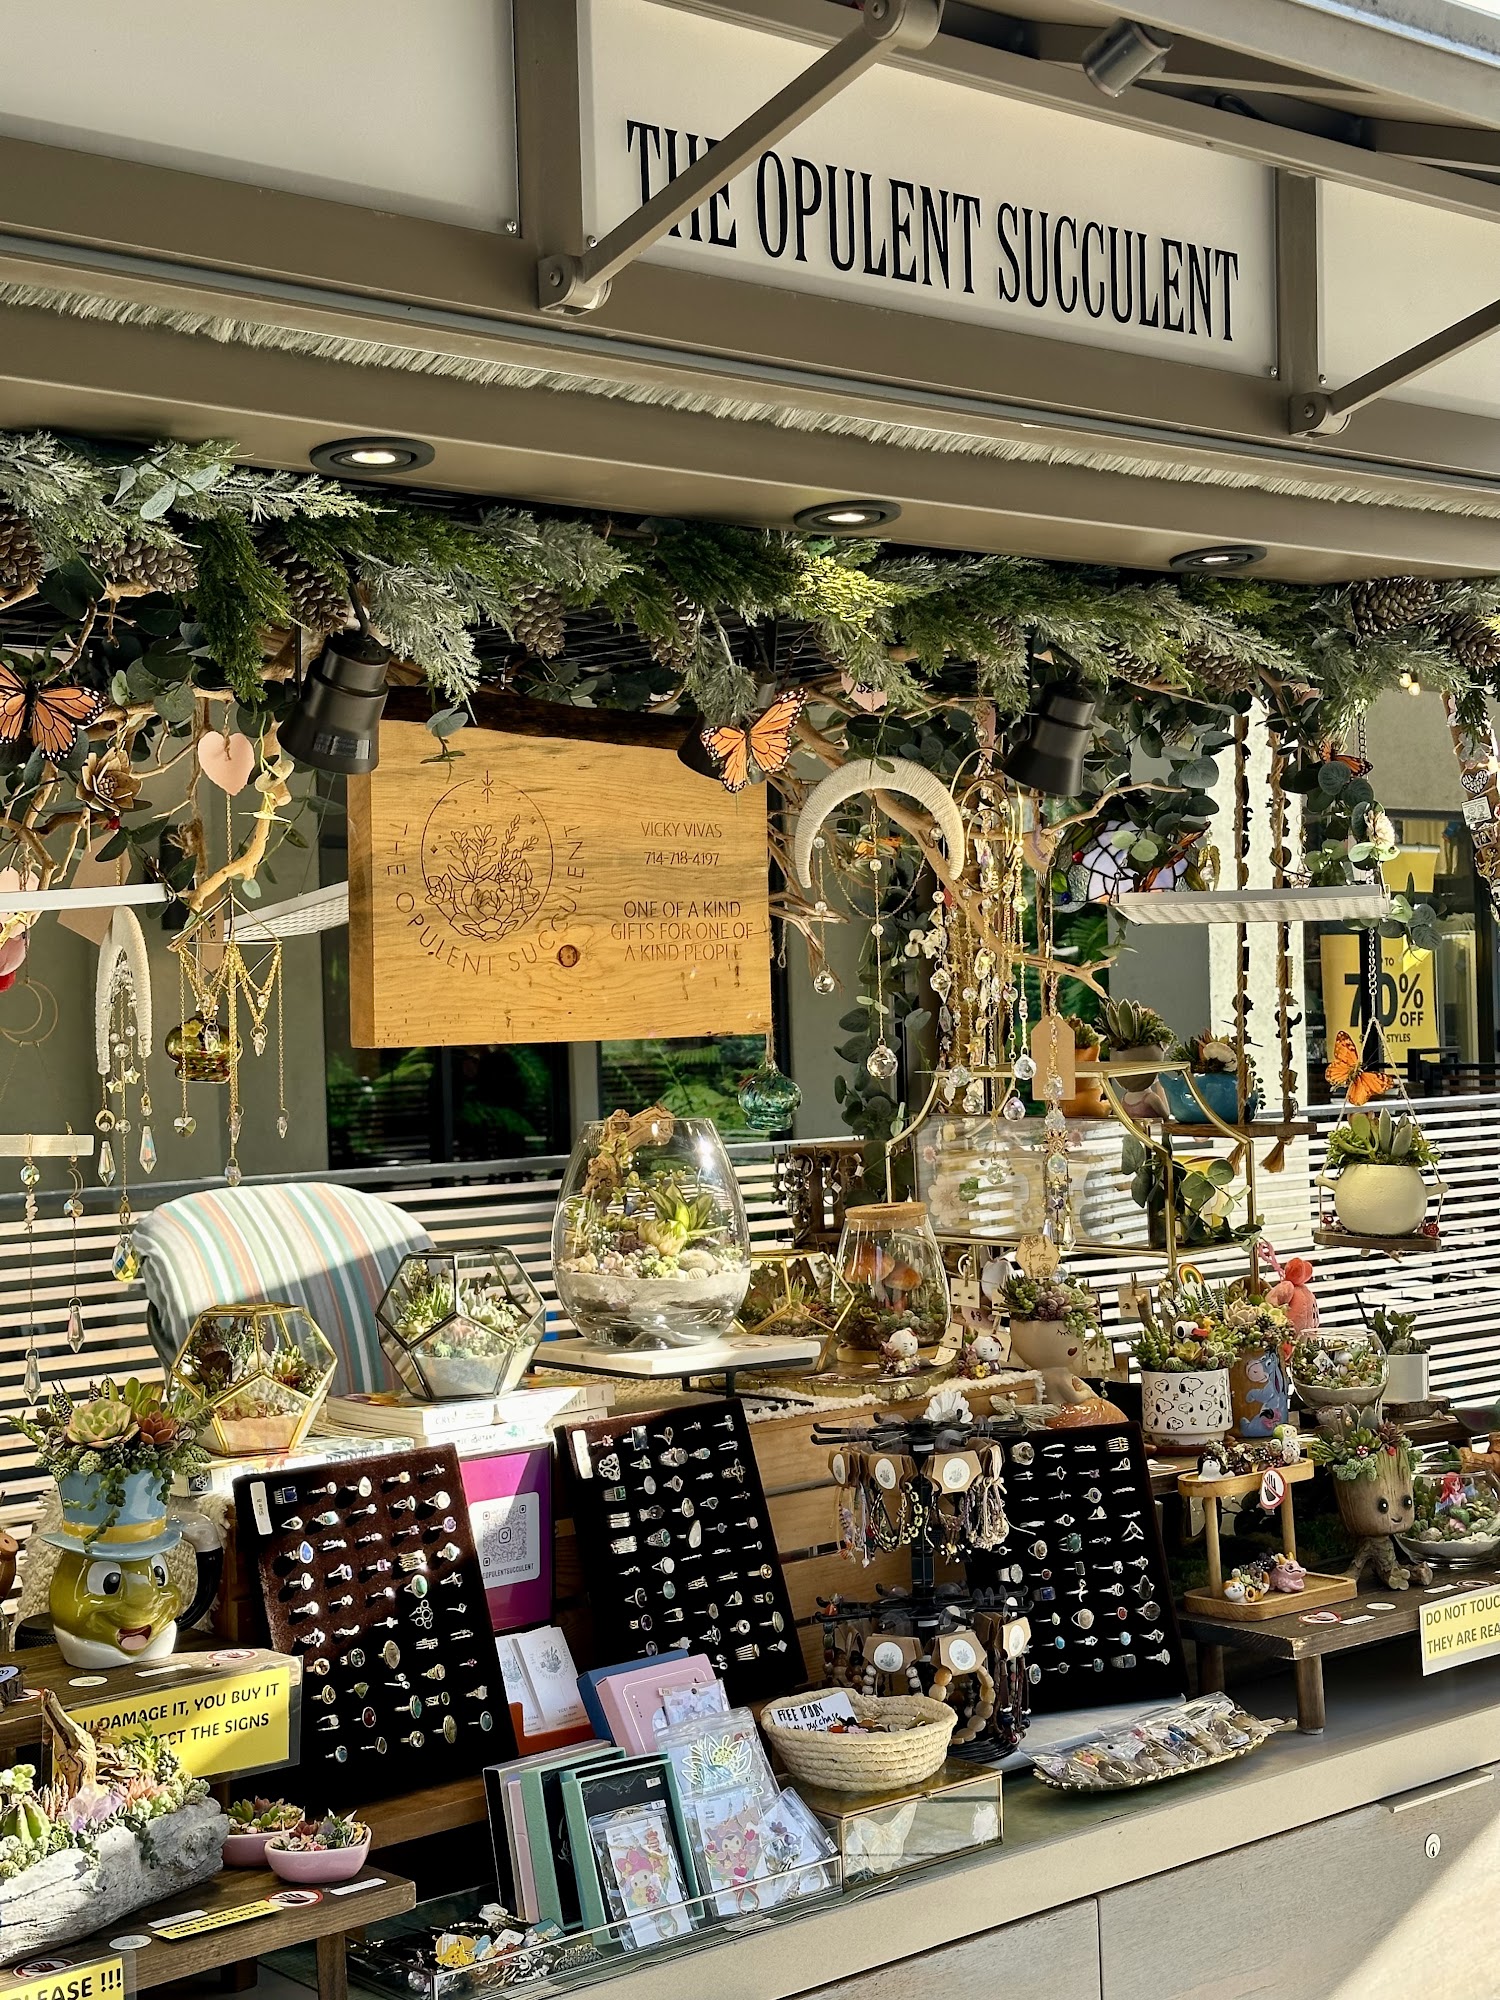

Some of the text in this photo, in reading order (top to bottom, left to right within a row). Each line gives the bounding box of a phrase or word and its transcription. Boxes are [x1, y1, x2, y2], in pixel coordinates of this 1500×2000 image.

[626, 119, 1239, 342] THE OPULENT SUCCULENT
[641, 822, 722, 838] VICKY VIVAS
[644, 851, 720, 866] 714-718-4197
[396, 892, 495, 976] OPULENT
[508, 825, 585, 972] SUCCULENT
[624, 901, 741, 918] ONE OF A KIND
[611, 922, 753, 940] GIFTS FOR ONE OF
[624, 944, 742, 961] A KIND PEOPLE
[1400, 1011, 1424, 1027] OFF
[1386, 1033, 1411, 1043] STYLES
[1426, 1610, 1441, 1626] DO
[1445, 1603, 1467, 1621] NOT
[1427, 1634, 1454, 1654] THEY
[1456, 1628, 1478, 1646] ARE
[98, 1704, 168, 1730] DAMAGE
[173, 1701, 190, 1716] IT,
[194, 1693, 226, 1711] YOU
[232, 1686, 261, 1704] BUY
[266, 1682, 280, 1698] IT
[777, 1708, 798, 1722] FREE
[191, 1723, 220, 1740] THE
[225, 1713, 270, 1733] SIGNS
[101, 1967, 121, 1992] !!!
